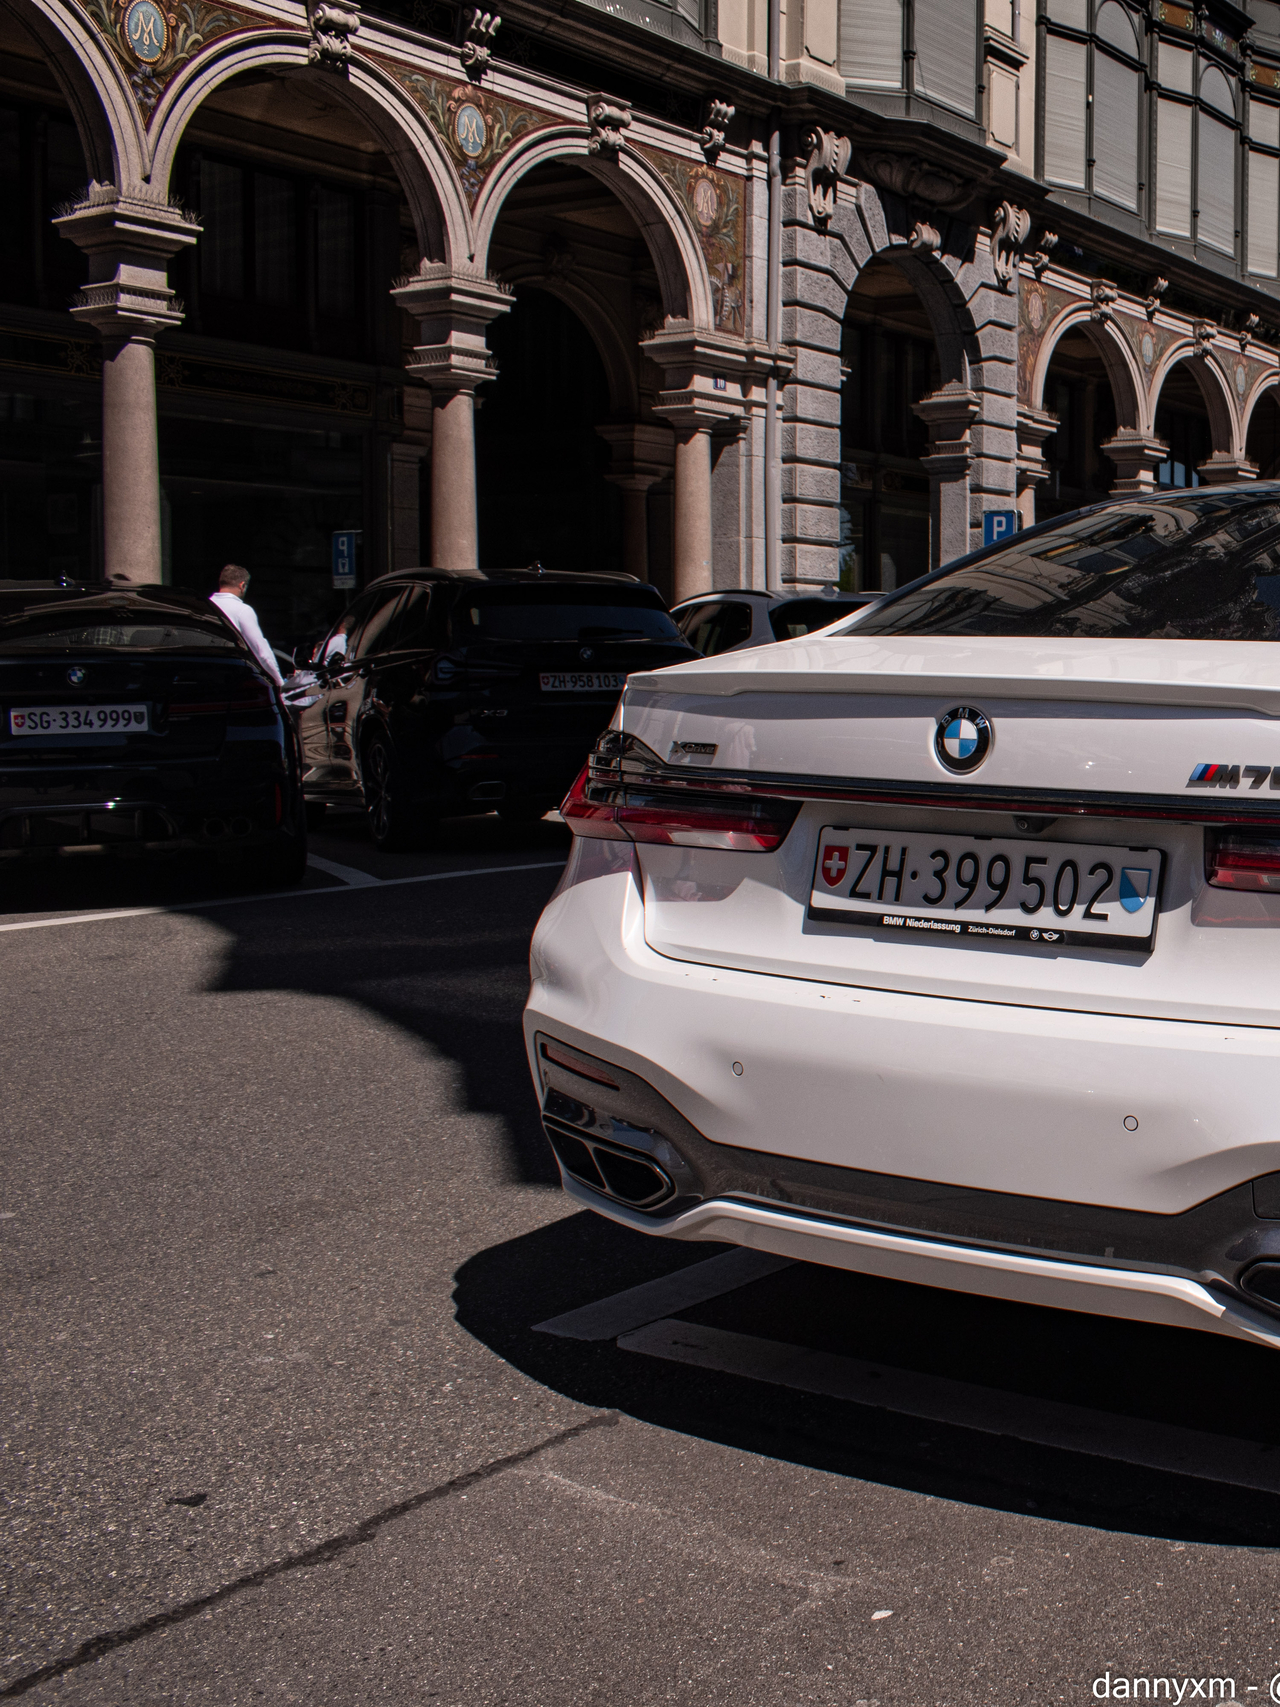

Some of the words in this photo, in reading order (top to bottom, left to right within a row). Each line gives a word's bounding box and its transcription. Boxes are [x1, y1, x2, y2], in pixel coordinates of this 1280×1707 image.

[993, 516, 1007, 541] P
[941, 707, 988, 729] BMW
[883, 915, 904, 926] BMW
[905, 917, 961, 932] Niederlassung
[967, 925, 1016, 937] Zürich-Dielsdorf
